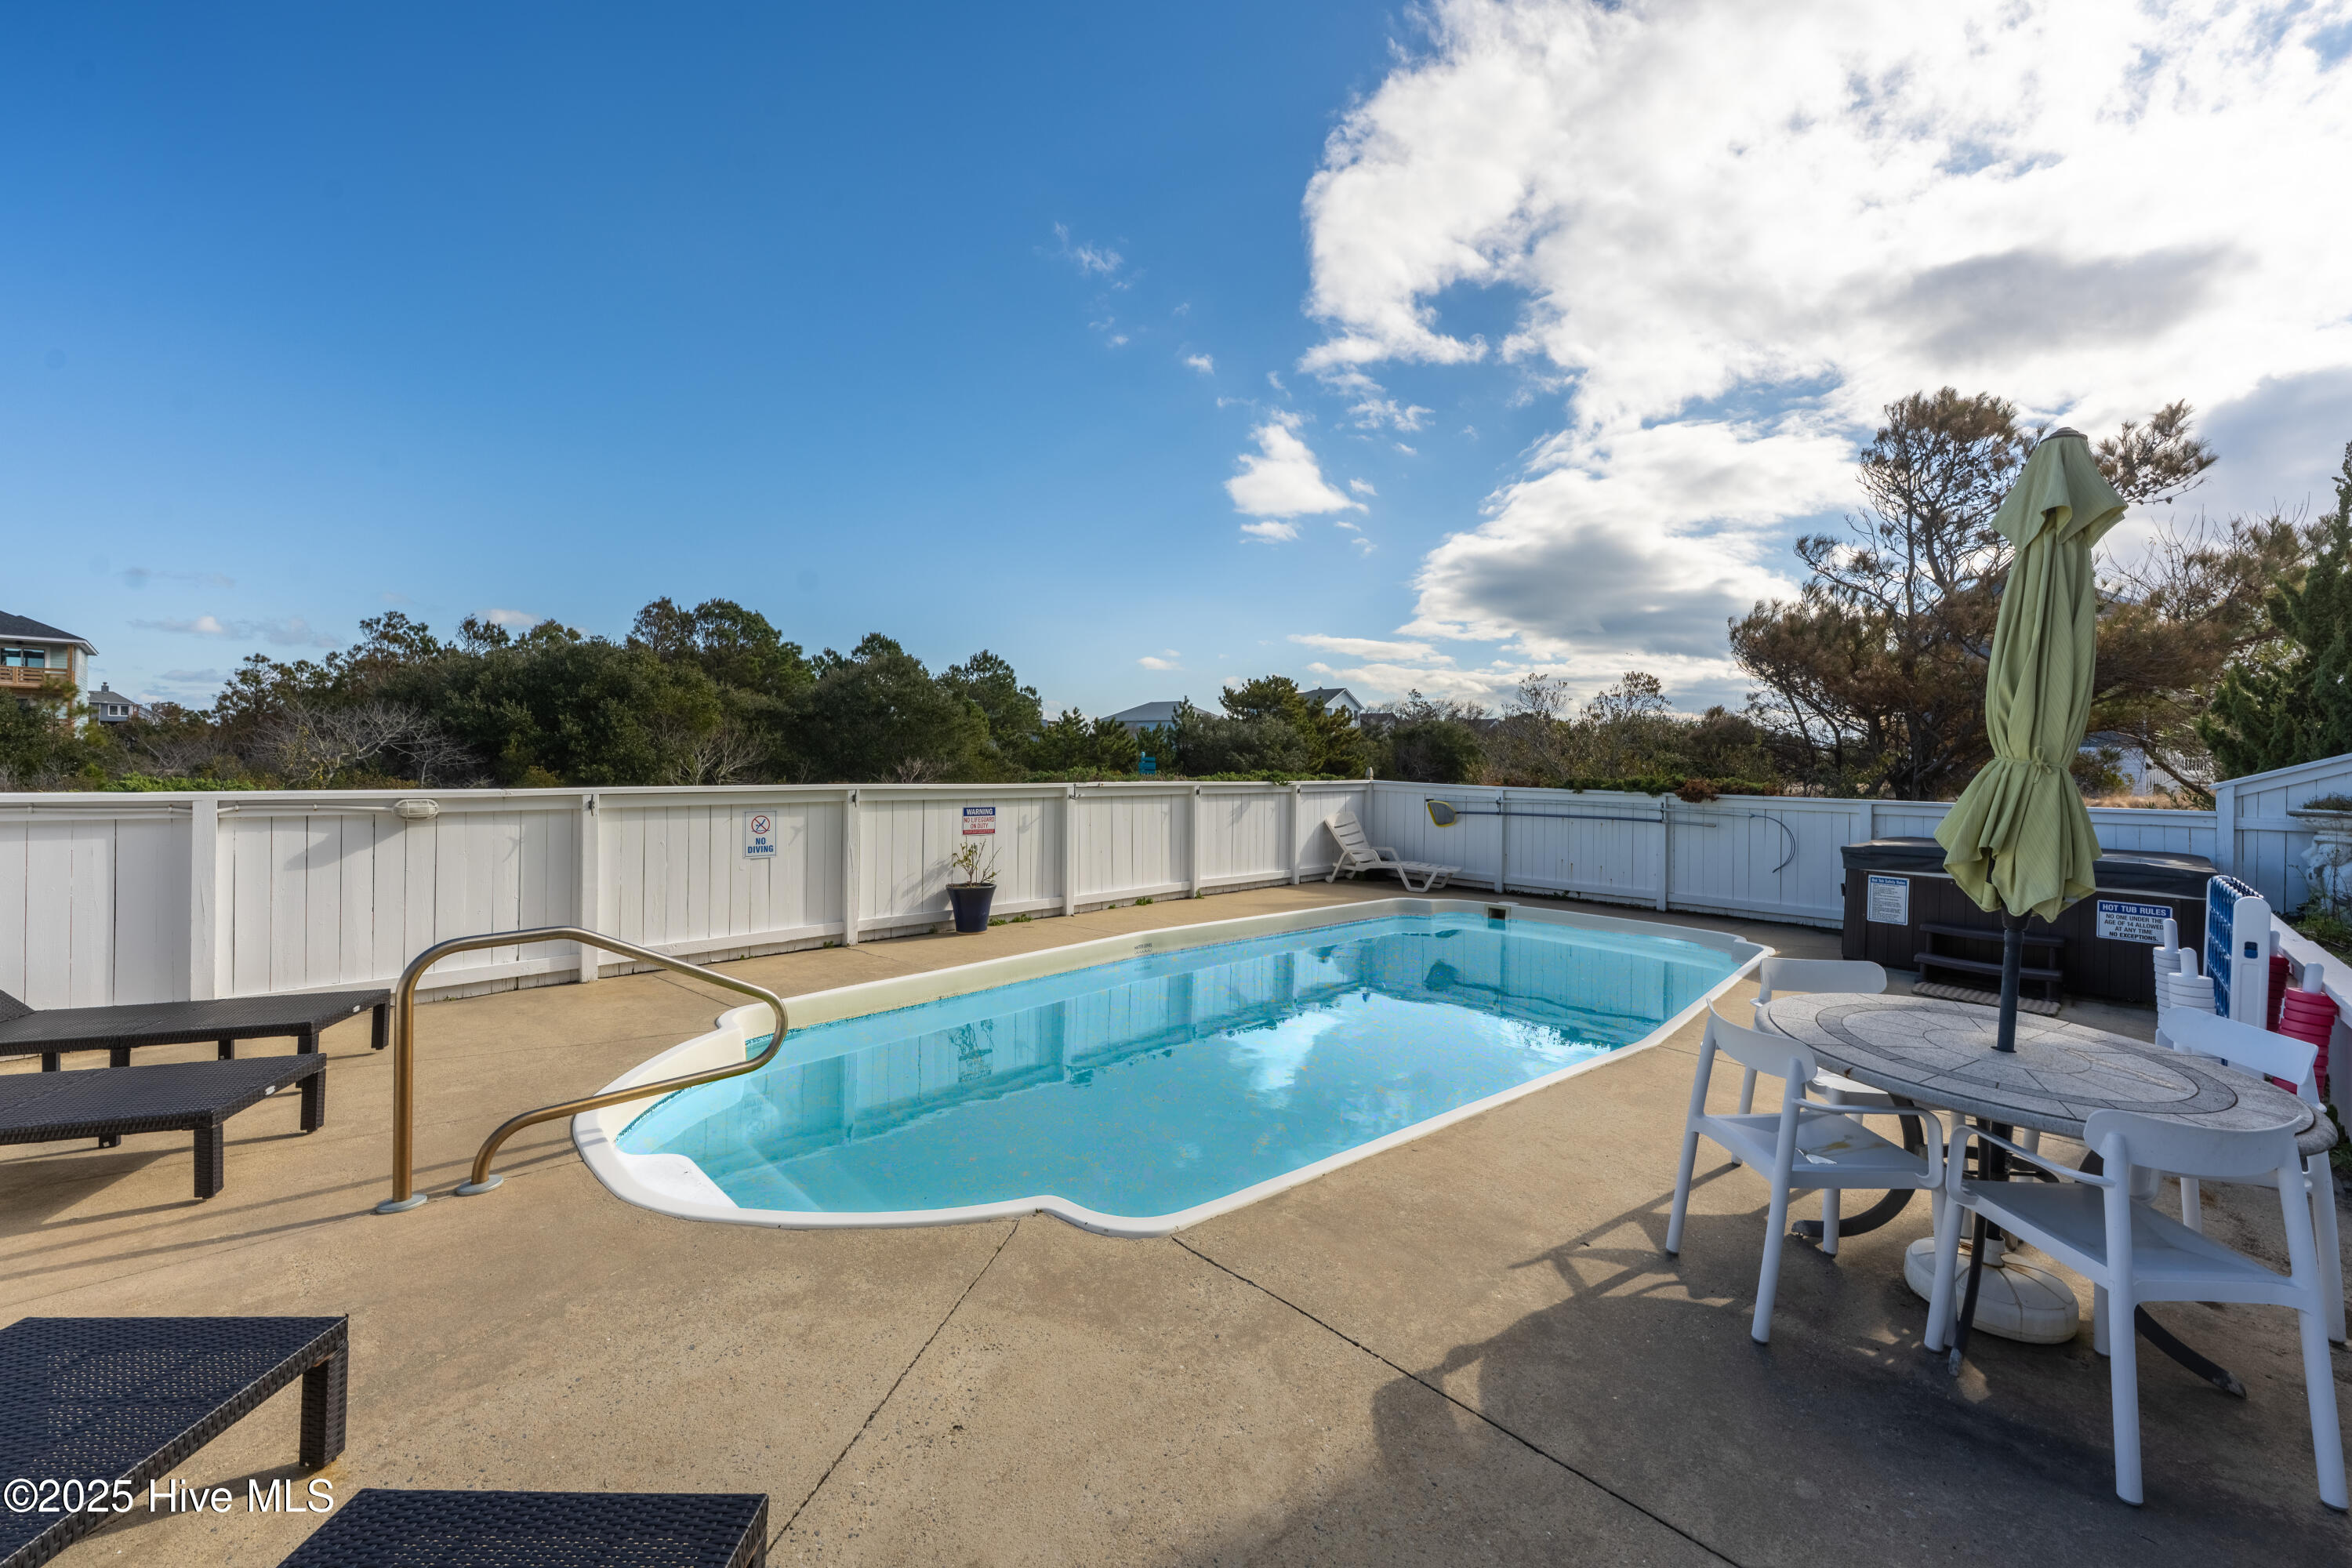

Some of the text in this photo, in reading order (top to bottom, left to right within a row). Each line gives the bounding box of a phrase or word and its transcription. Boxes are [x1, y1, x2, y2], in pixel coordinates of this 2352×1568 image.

[747, 844, 774, 854] DIVING
[2140, 908, 2166, 916] RULES
[2135, 922, 2164, 931] ALLOWED
[2119, 932, 2158, 942] EXCEPTIONS.
